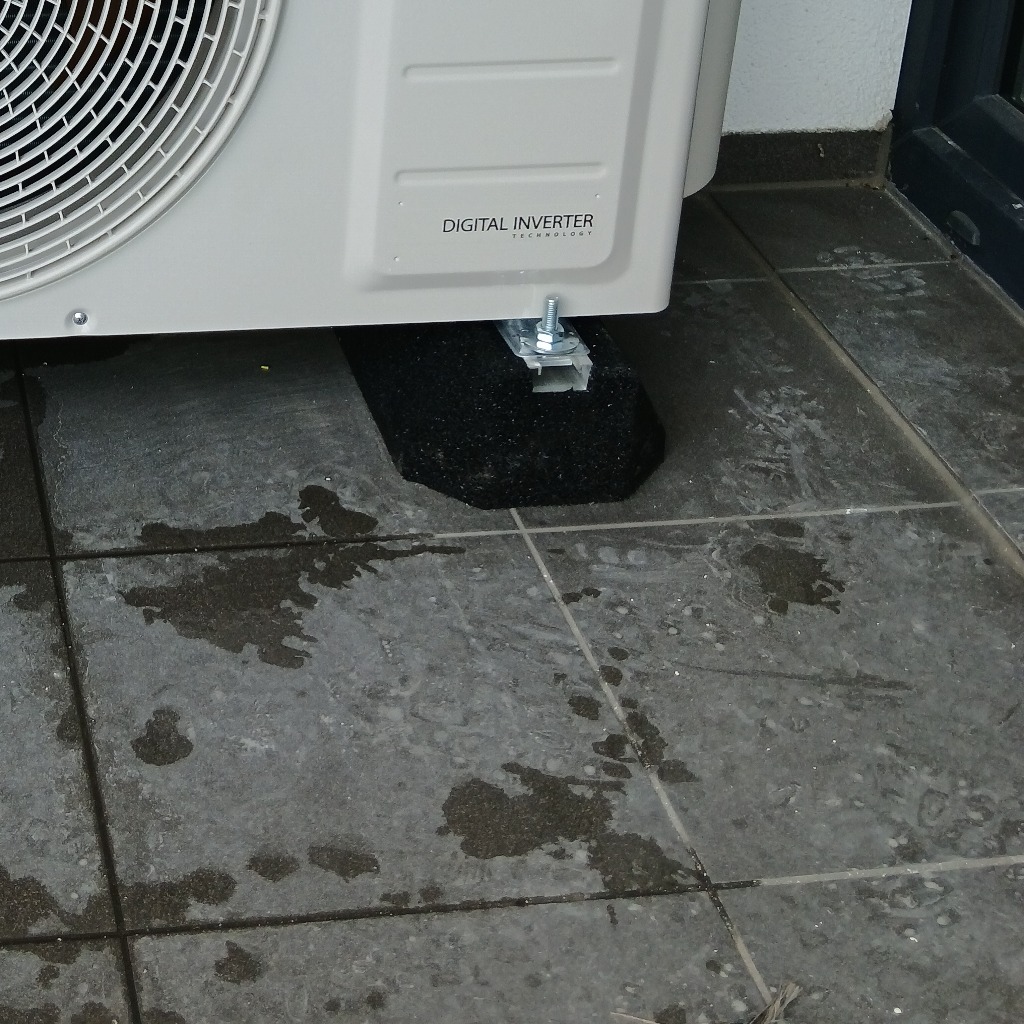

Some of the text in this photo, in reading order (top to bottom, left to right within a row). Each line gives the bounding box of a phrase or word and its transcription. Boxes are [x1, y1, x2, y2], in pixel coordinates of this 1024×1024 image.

[442, 214, 594, 233] DIGITAL INVERTER
[512, 230, 592, 239] TECHNOLOGY
